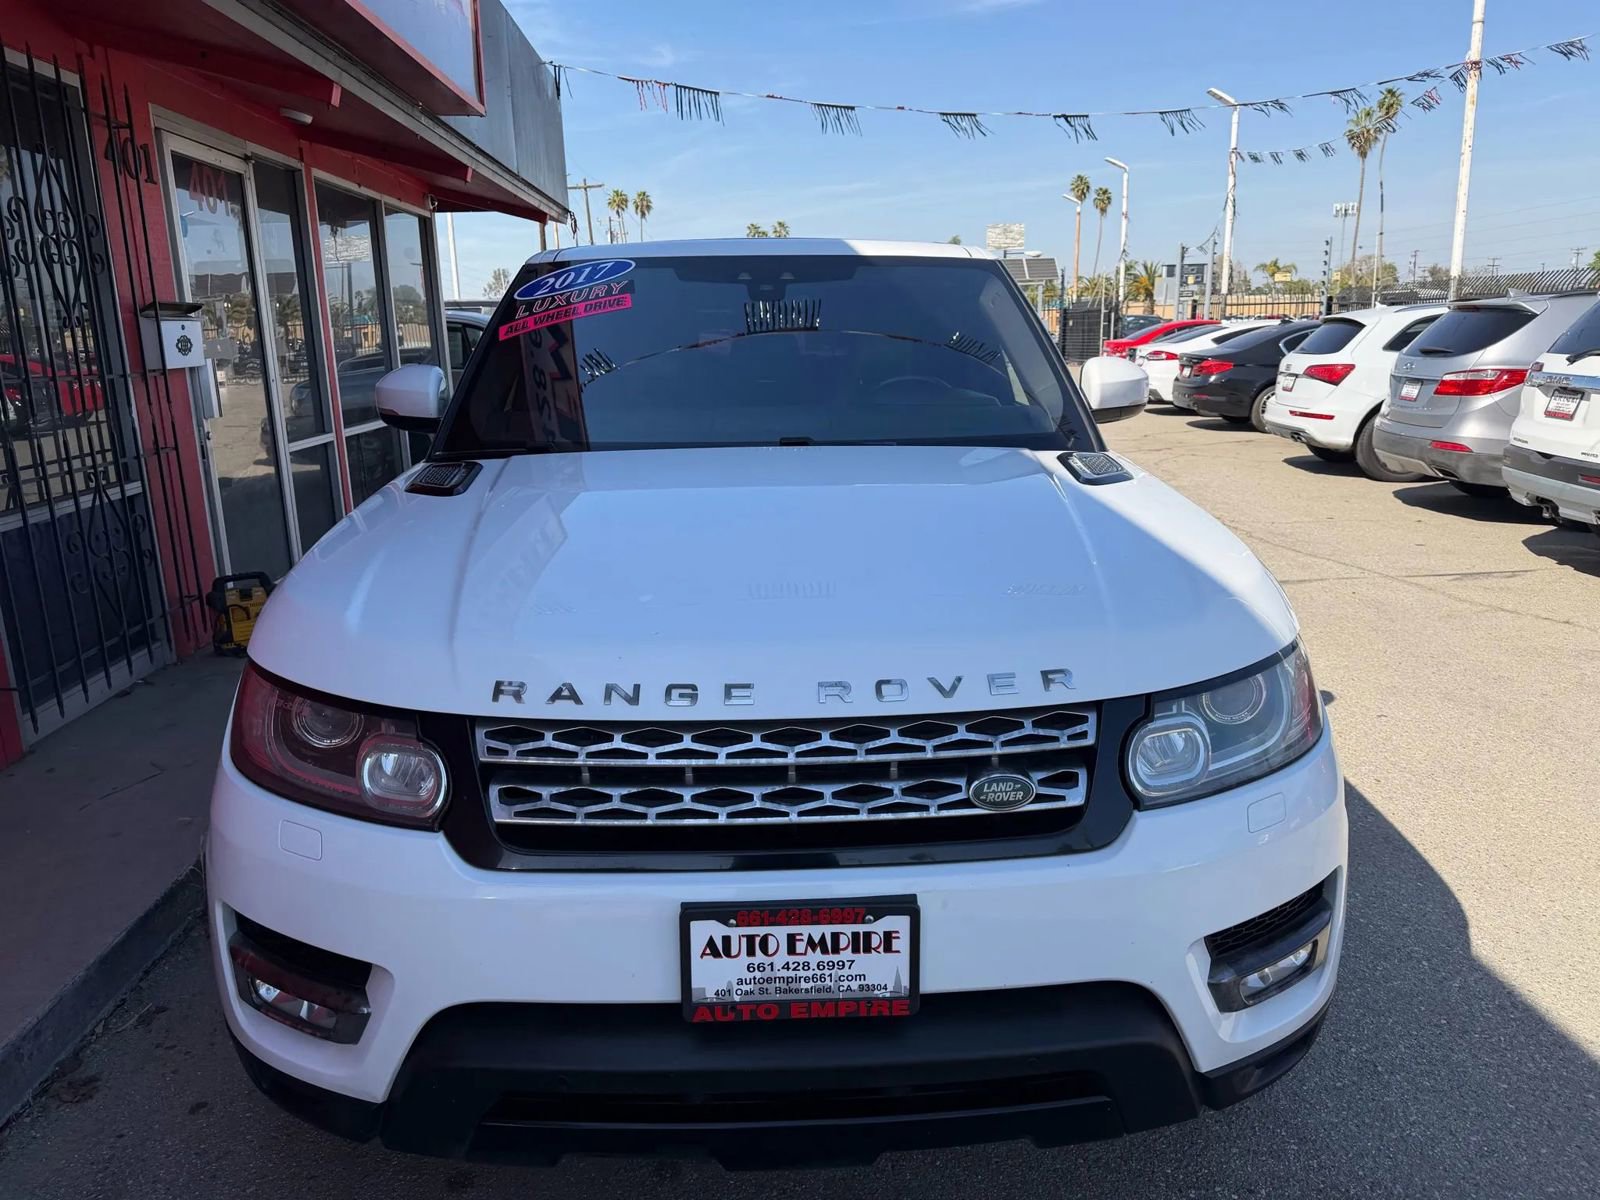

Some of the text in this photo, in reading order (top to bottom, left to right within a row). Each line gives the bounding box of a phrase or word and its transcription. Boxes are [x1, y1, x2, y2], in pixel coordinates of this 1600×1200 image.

[189, 162, 230, 216] 401
[533, 261, 615, 297] 2017
[515, 280, 629, 319] LUXURY
[504, 296, 627, 336] ALL WHEEL DRIVE
[492, 668, 1077, 707] RANGE ROVER
[983, 781, 1014, 793] LAND
[986, 790, 1024, 803] ROVER
[736, 907, 866, 927] 661-428-6997
[700, 930, 901, 959] AUTO EMPIRE
[746, 959, 856, 973] 661.428.6997
[714, 988, 731, 997] 401
[735, 987, 755, 996] Oak
[758, 986, 772, 996] St.
[775, 984, 835, 995] Bakersfield,
[858, 983, 888, 993] 93304
[736, 973, 866, 986] autoempire661.com
[692, 1000, 911, 1024] AUTO EMPIRE
